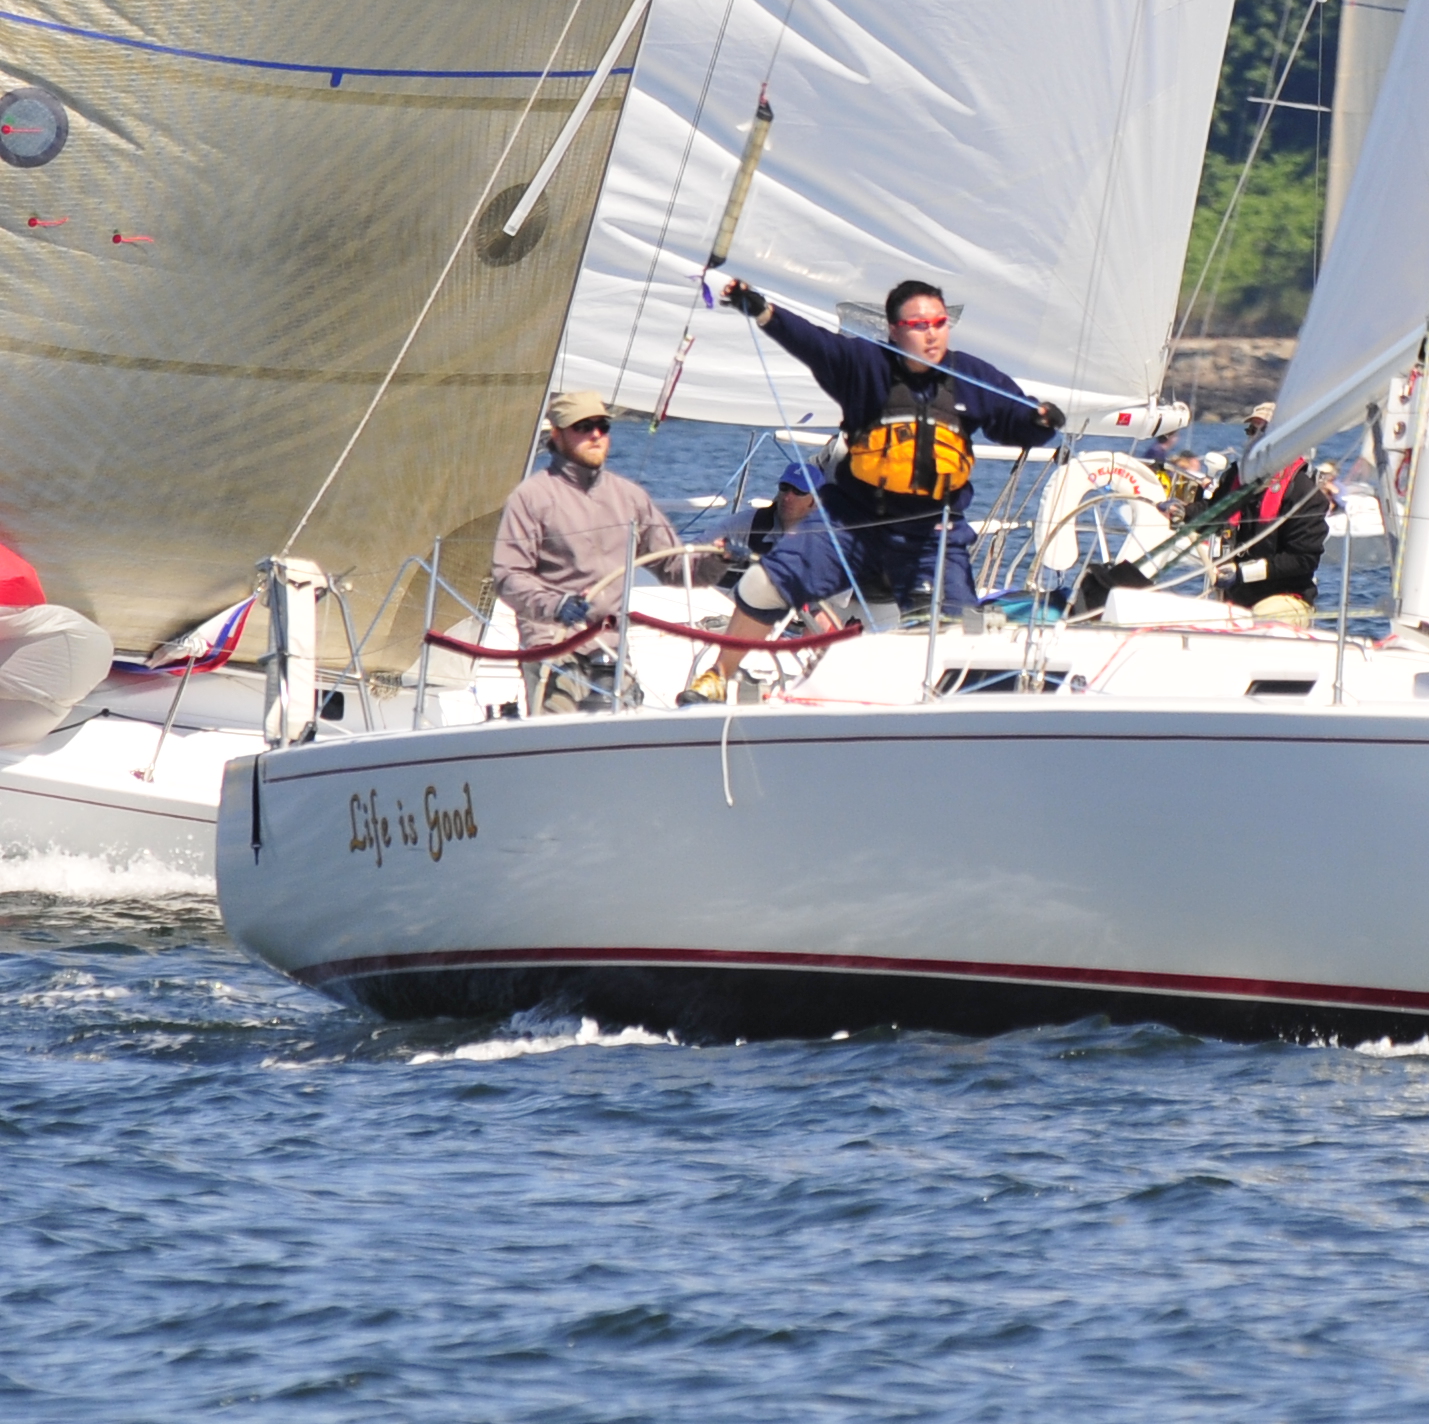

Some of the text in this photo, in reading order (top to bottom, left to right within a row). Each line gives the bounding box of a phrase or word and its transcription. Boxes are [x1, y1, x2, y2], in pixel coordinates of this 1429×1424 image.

[350, 781, 479, 869] Life is Good
